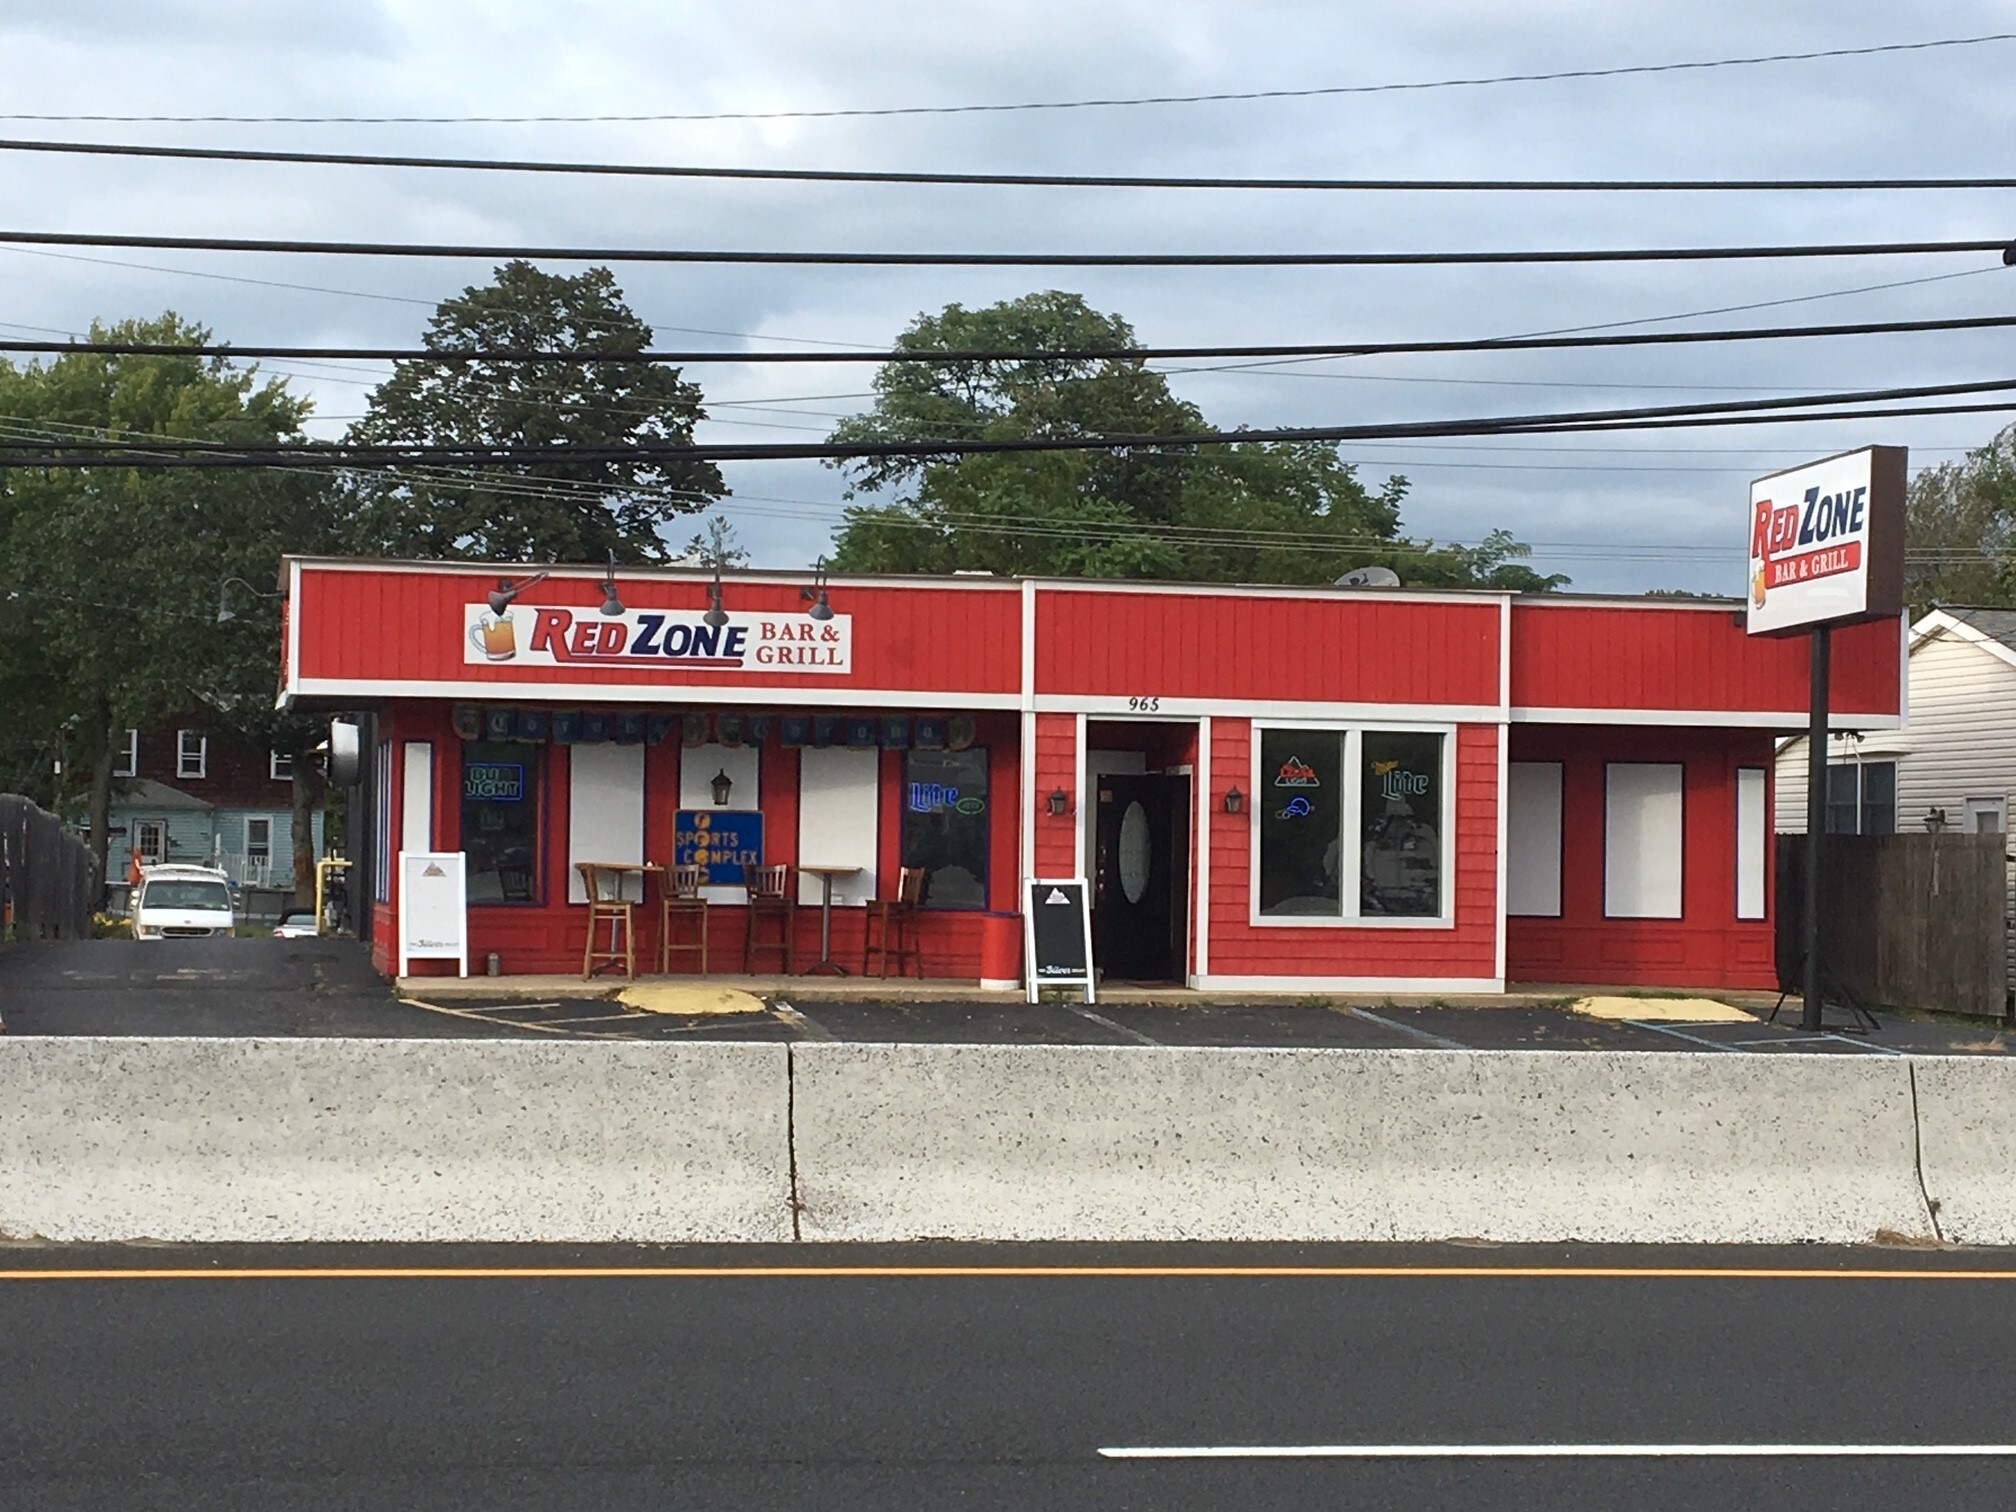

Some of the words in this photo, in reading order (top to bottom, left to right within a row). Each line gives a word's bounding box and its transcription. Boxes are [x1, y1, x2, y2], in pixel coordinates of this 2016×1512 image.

[1752, 499, 1799, 559] RED
[1798, 486, 1867, 546] ZONE
[1774, 561, 1796, 584] BAR
[1799, 559, 1808, 578] &
[1811, 549, 1849, 576] GRILL
[529, 608, 628, 655] RED
[630, 614, 749, 657] ZONE
[755, 645, 844, 666] GRILL
[1128, 696, 1159, 712] 965
[465, 780, 519, 796] LIGHT
[1381, 770, 1429, 800] Lite
[677, 831, 739, 847] SPORTS
[683, 849, 757, 866] COMPLEX
